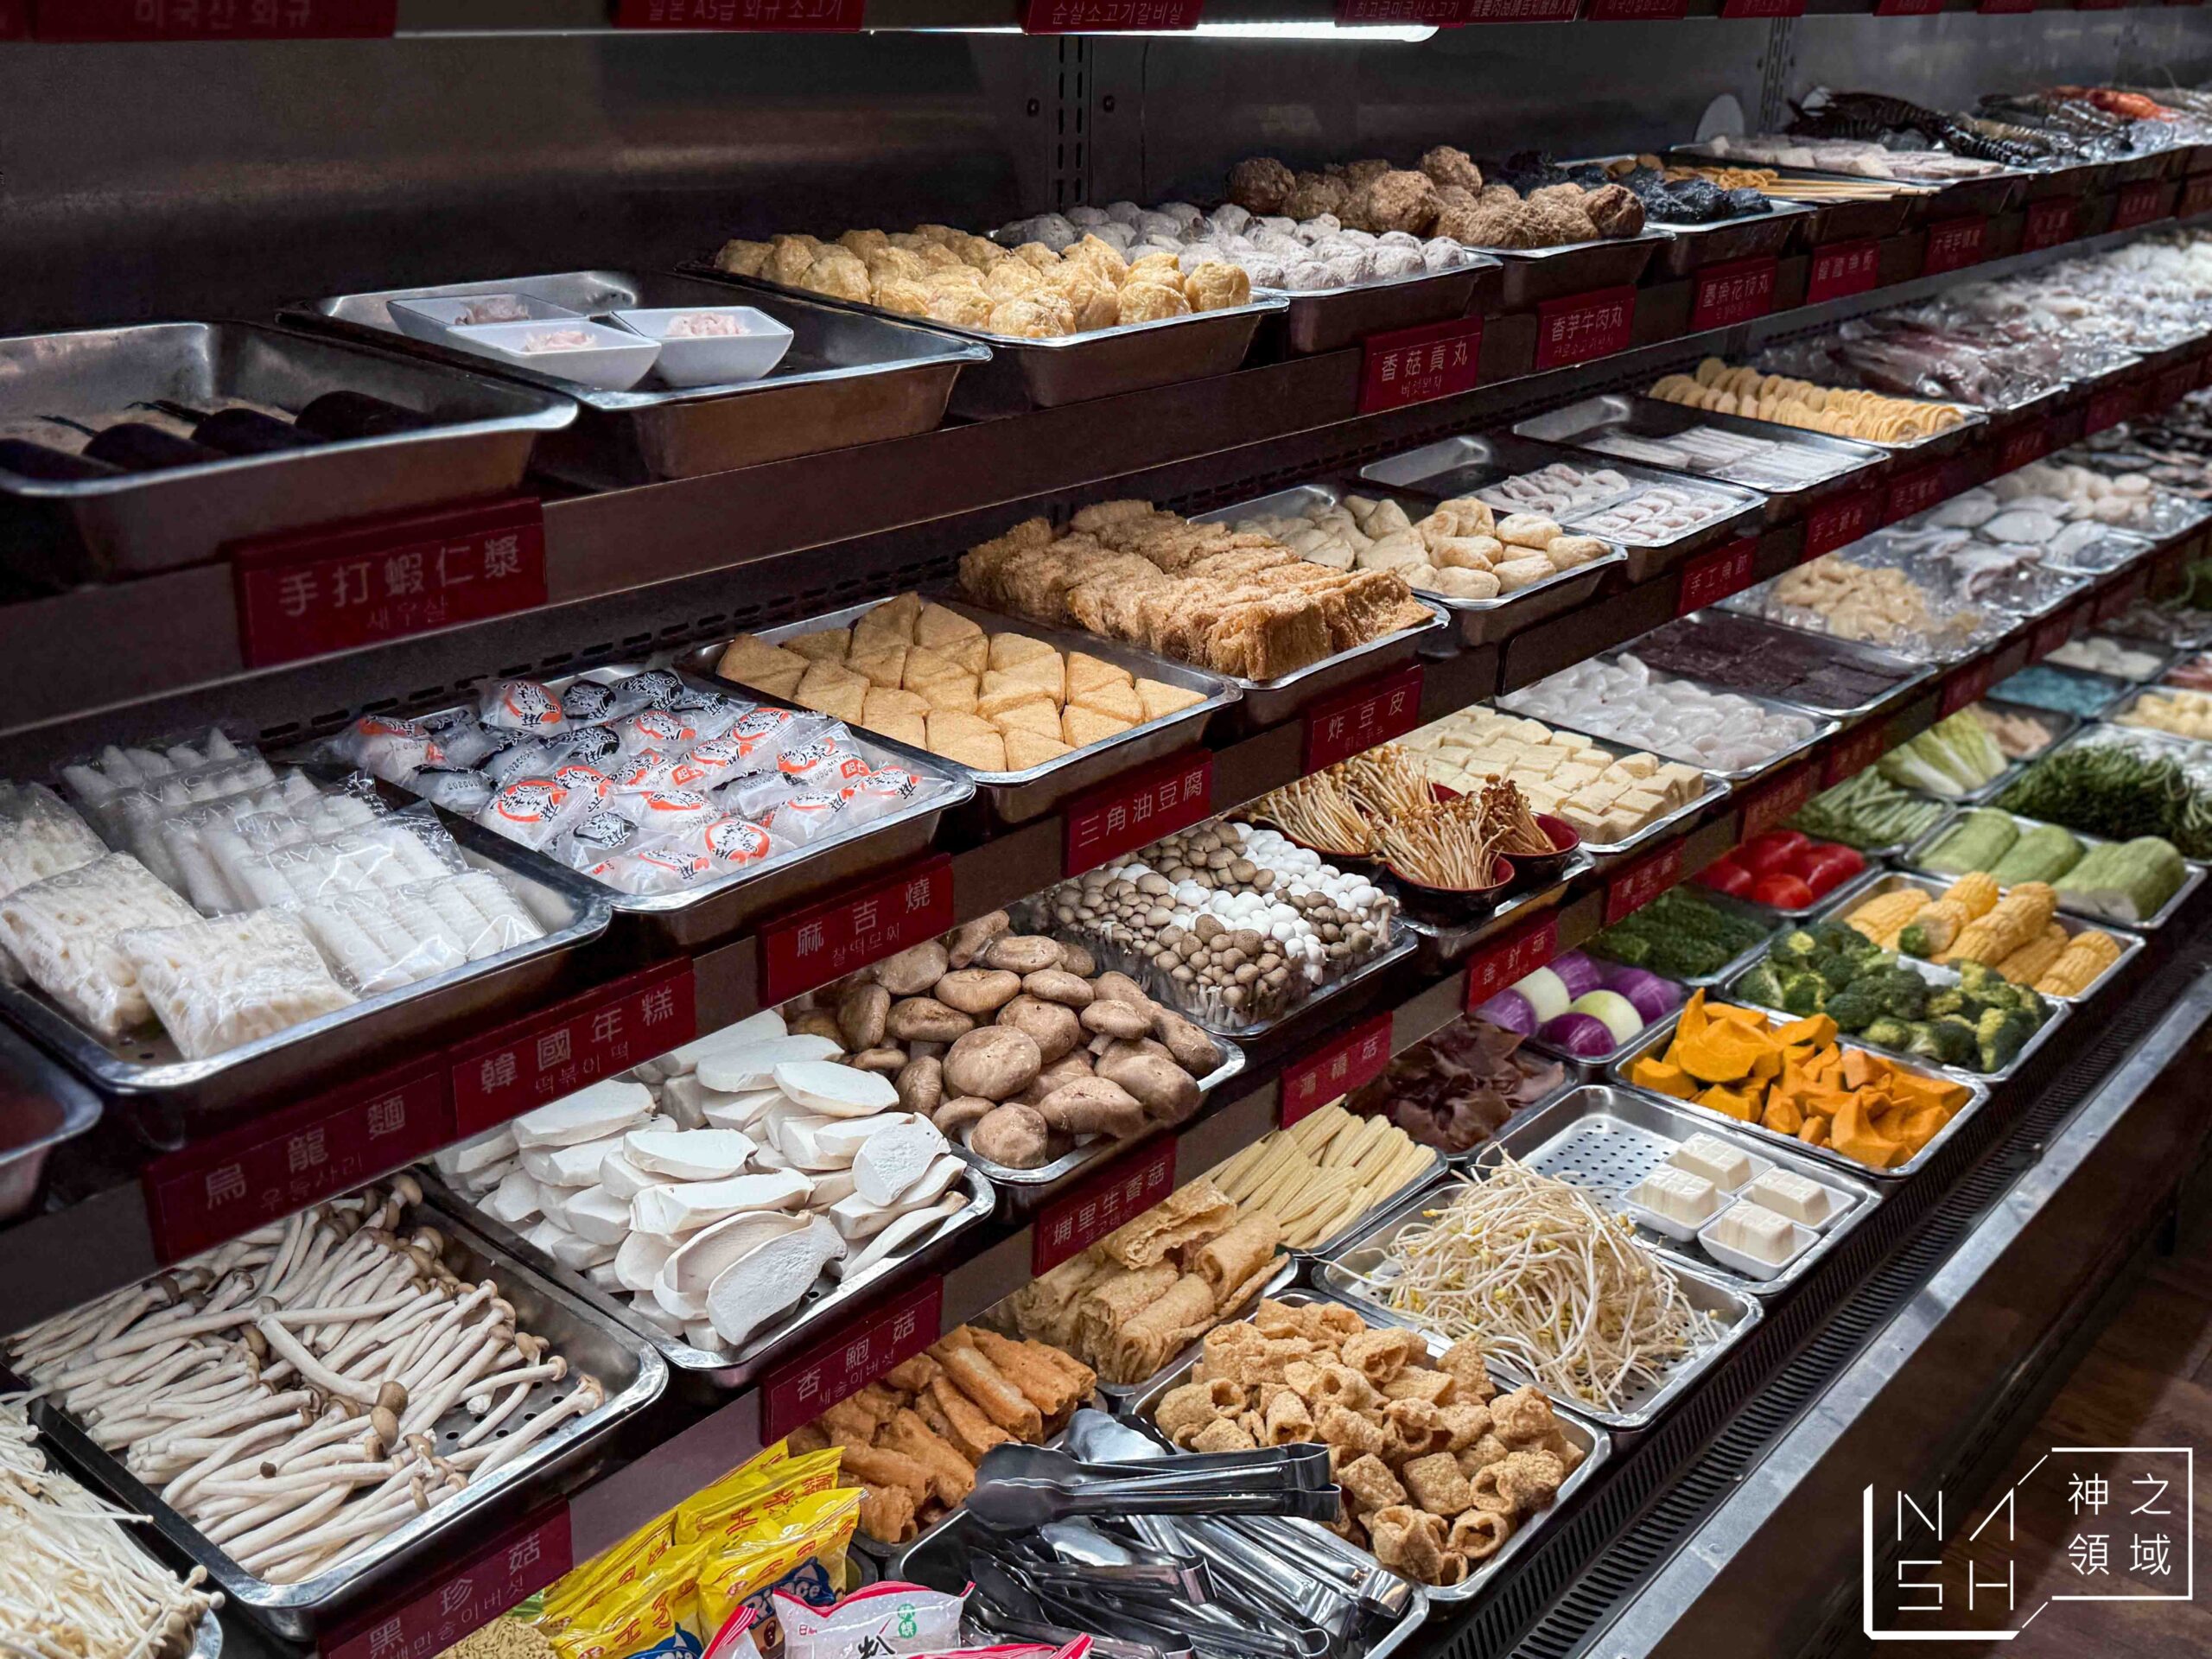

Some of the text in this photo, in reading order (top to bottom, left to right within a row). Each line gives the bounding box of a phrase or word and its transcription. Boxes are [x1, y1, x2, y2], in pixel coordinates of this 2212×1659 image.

[1381, 340, 1468, 383] 香菇貢丸
[1552, 304, 1623, 342] 香芋牛肉丸
[1327, 691, 1405, 742] 炸豆皮
[1078, 770, 1203, 848] 三角油豆腐
[797, 874, 932, 958] 麻吉燒
[480, 986, 674, 1094] 韓國年糕
[1052, 1162, 1166, 1246] 埔里生香菇
[797, 1309, 915, 1402] 杏鮑菇
[370, 1535, 542, 1659] 黑珍菇
